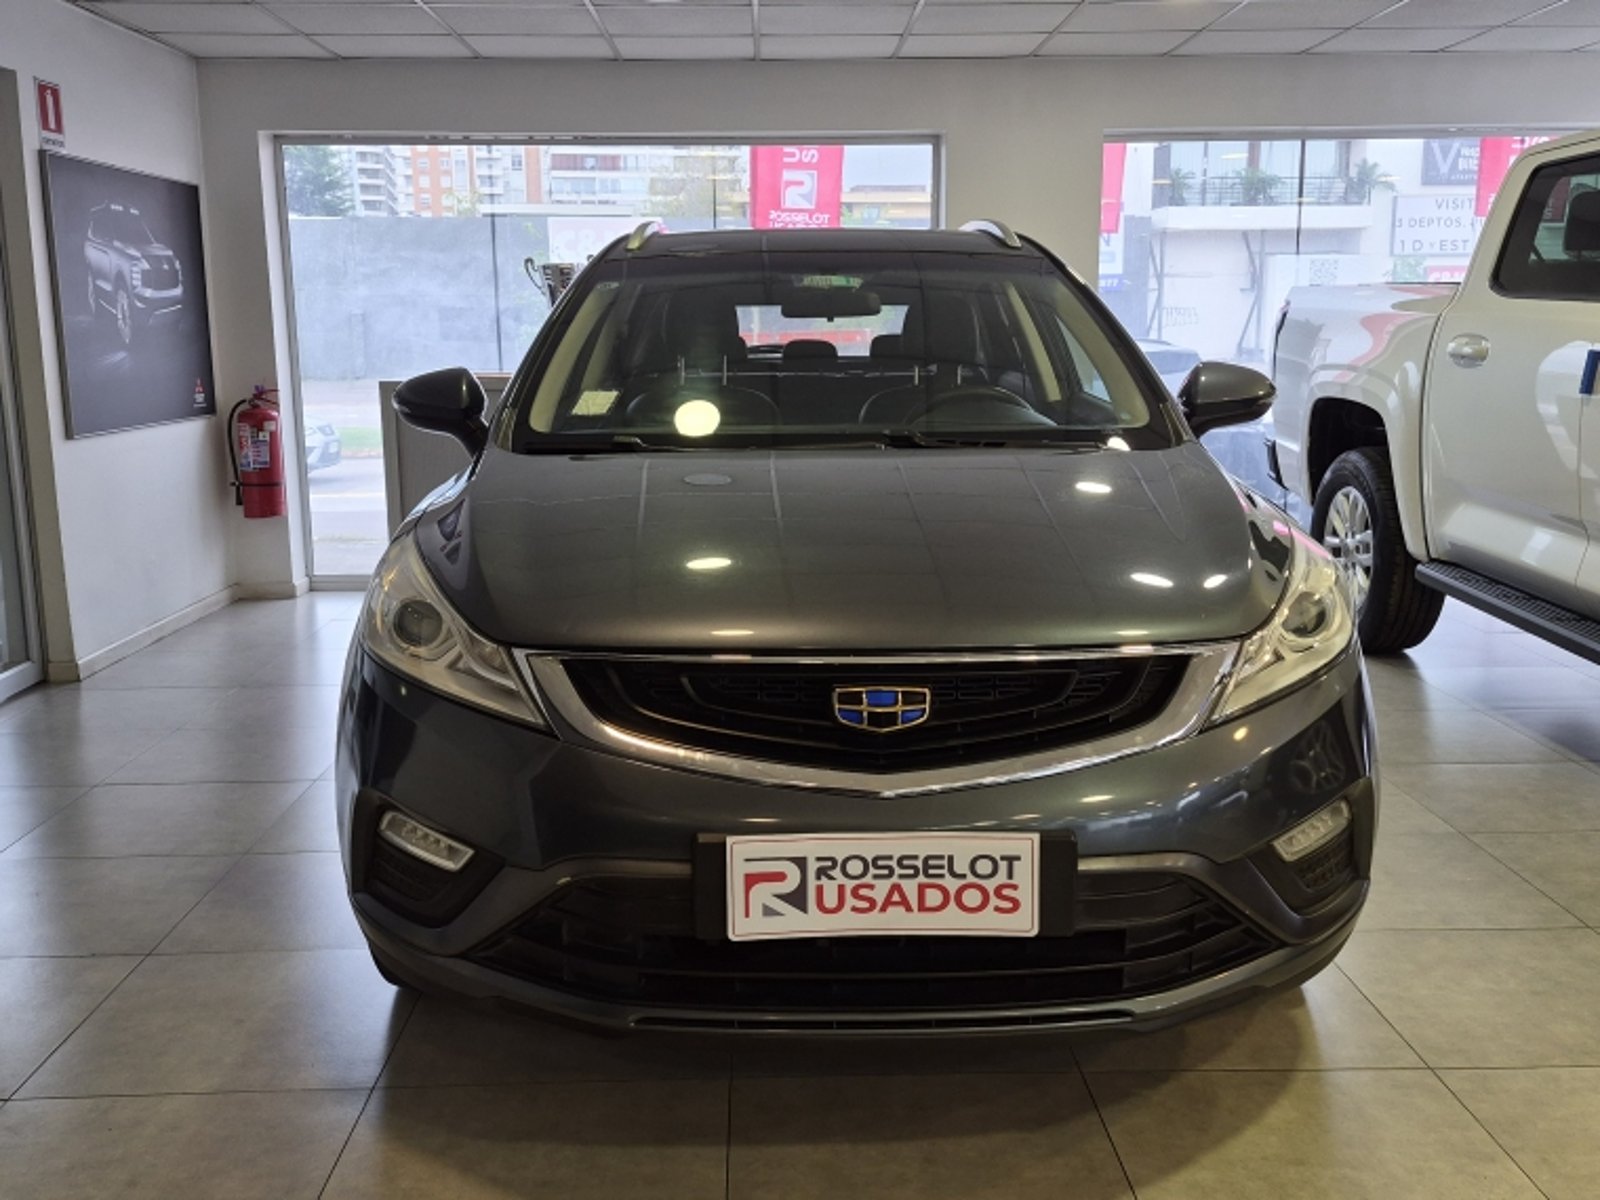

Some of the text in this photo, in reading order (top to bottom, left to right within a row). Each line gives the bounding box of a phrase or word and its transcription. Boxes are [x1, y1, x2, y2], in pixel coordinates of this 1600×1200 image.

[769, 210, 831, 224] ROSSELOT
[815, 854, 1022, 881] ROSSELOT
[815, 882, 1022, 915] USADOS
